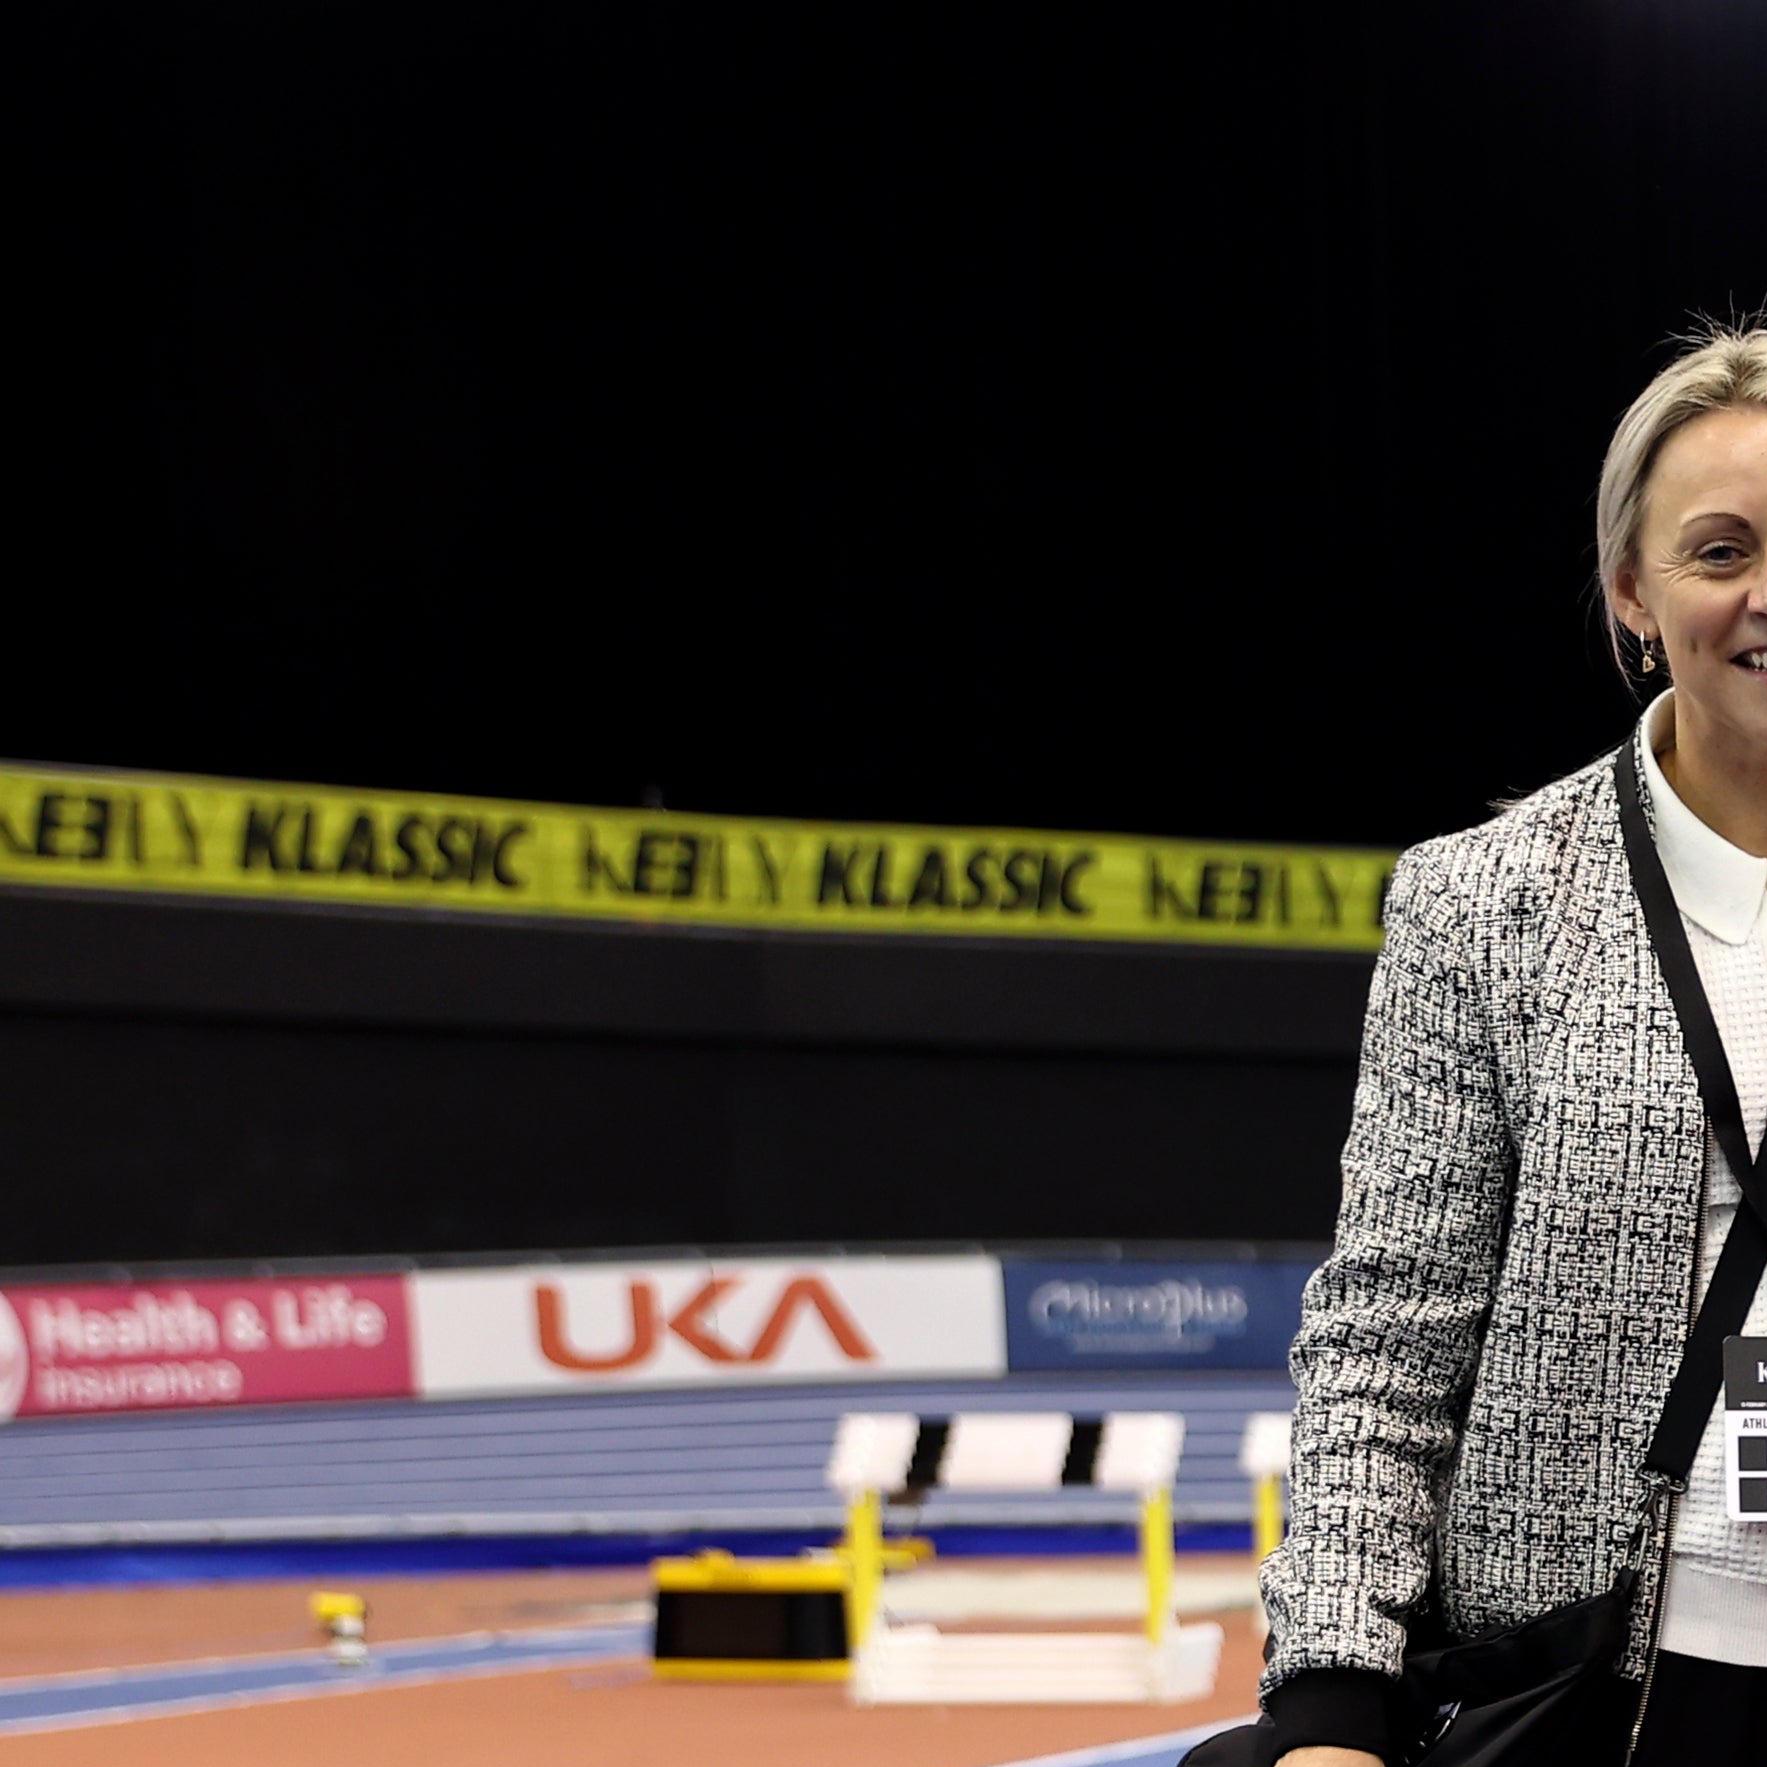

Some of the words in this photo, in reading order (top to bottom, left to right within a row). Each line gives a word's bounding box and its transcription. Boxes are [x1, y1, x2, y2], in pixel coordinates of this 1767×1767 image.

[242, 803, 534, 888] KLASSIC
[819, 842, 1096, 918] KLASSIC
[29, 1290, 219, 1358] Health
[223, 1297, 271, 1351] &
[272, 1285, 389, 1348] Life
[533, 1269, 878, 1374] UKA
[36, 1358, 244, 1408] Insurance
